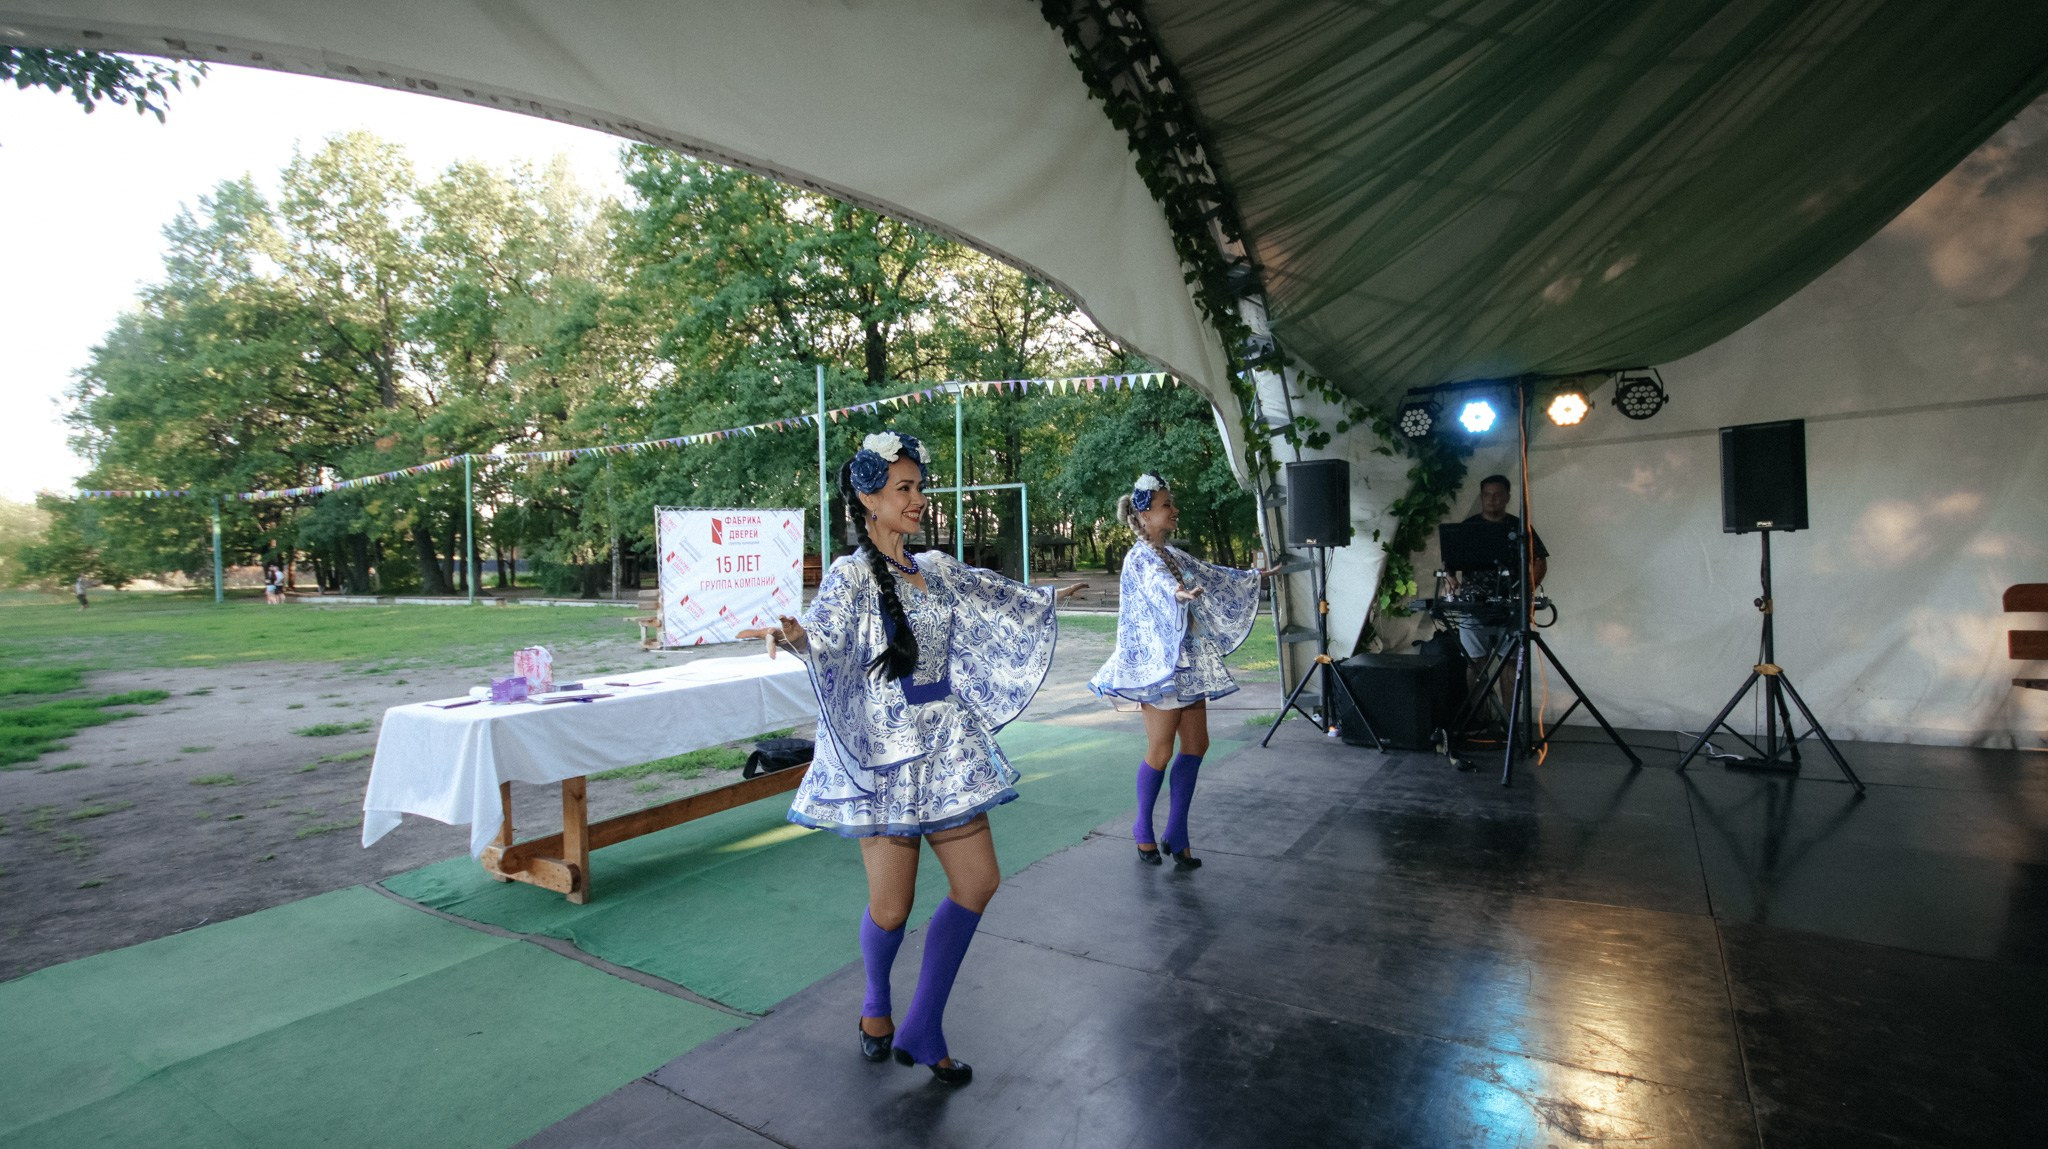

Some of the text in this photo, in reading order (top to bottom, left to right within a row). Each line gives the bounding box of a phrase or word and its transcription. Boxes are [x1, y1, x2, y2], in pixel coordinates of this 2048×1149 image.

[724, 516, 762, 525] ФАБРИКА
[729, 528, 759, 540] ДВЕРЕЙ
[716, 554, 761, 574] 15 ЛЕТ
[700, 579, 732, 591] ГРУППА
[734, 574, 776, 589] КОМПАНИЙ
